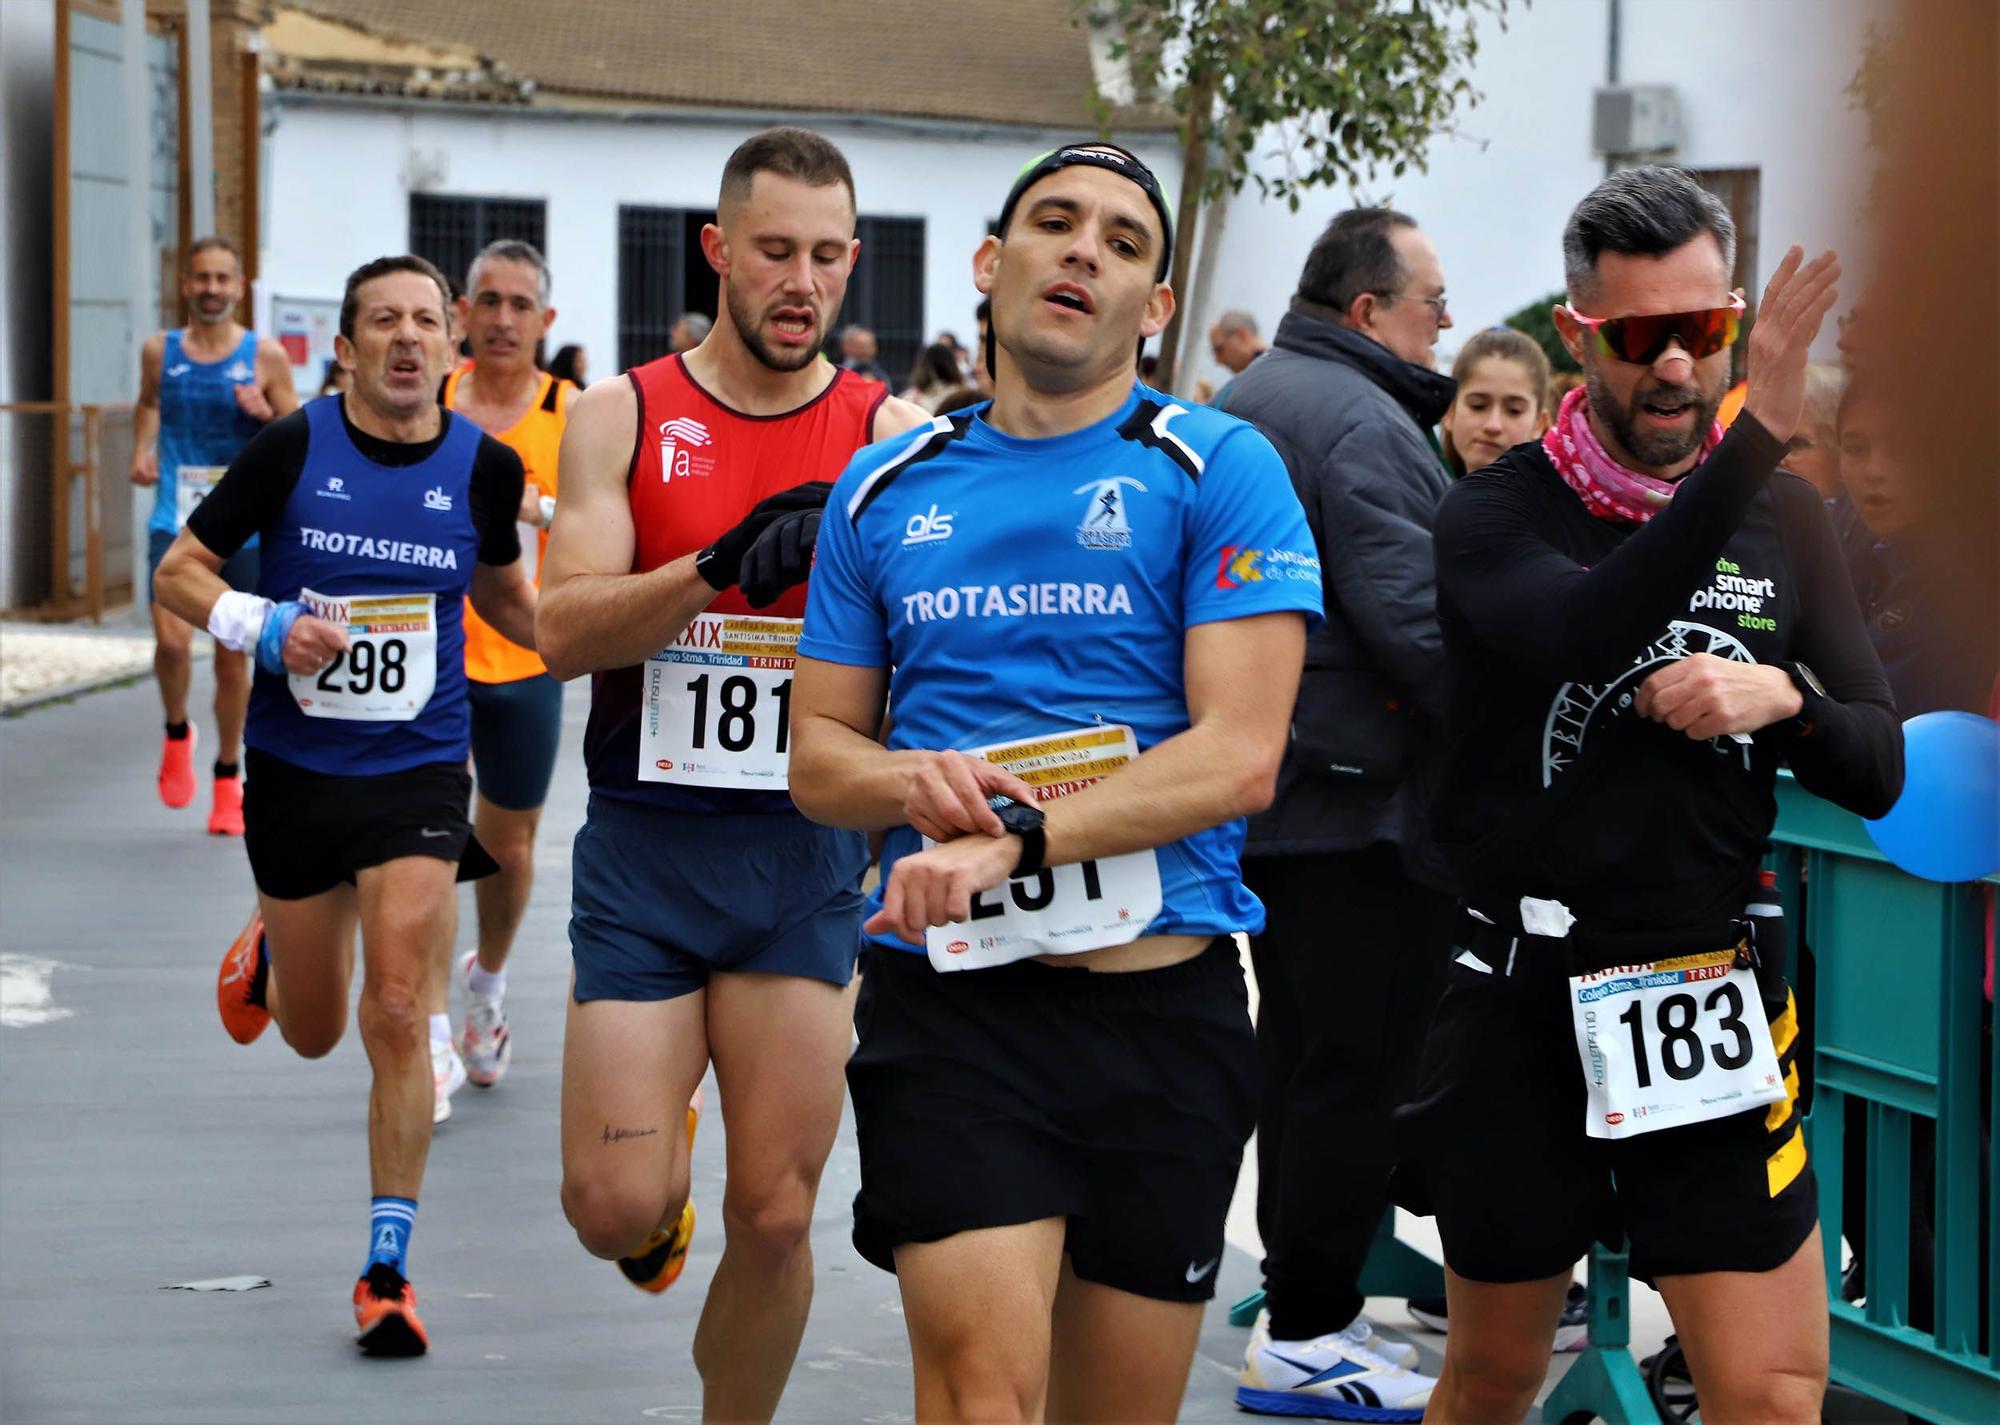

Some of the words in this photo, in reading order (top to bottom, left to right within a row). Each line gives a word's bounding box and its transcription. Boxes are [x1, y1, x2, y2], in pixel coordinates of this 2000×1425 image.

[300, 527, 457, 570] TROTASIERRA
[1715, 557, 1741, 575] the
[1715, 574, 1776, 598] smart
[902, 582, 1133, 625] TROTASIERRA
[1689, 587, 1761, 613] phone
[1737, 613, 1776, 632] store
[724, 632, 765, 641] SANTISIMA
[317, 639, 407, 695] 298
[708, 654, 743, 666] Trinidad
[687, 673, 793, 753] 181
[1619, 981, 1753, 1088] 183
